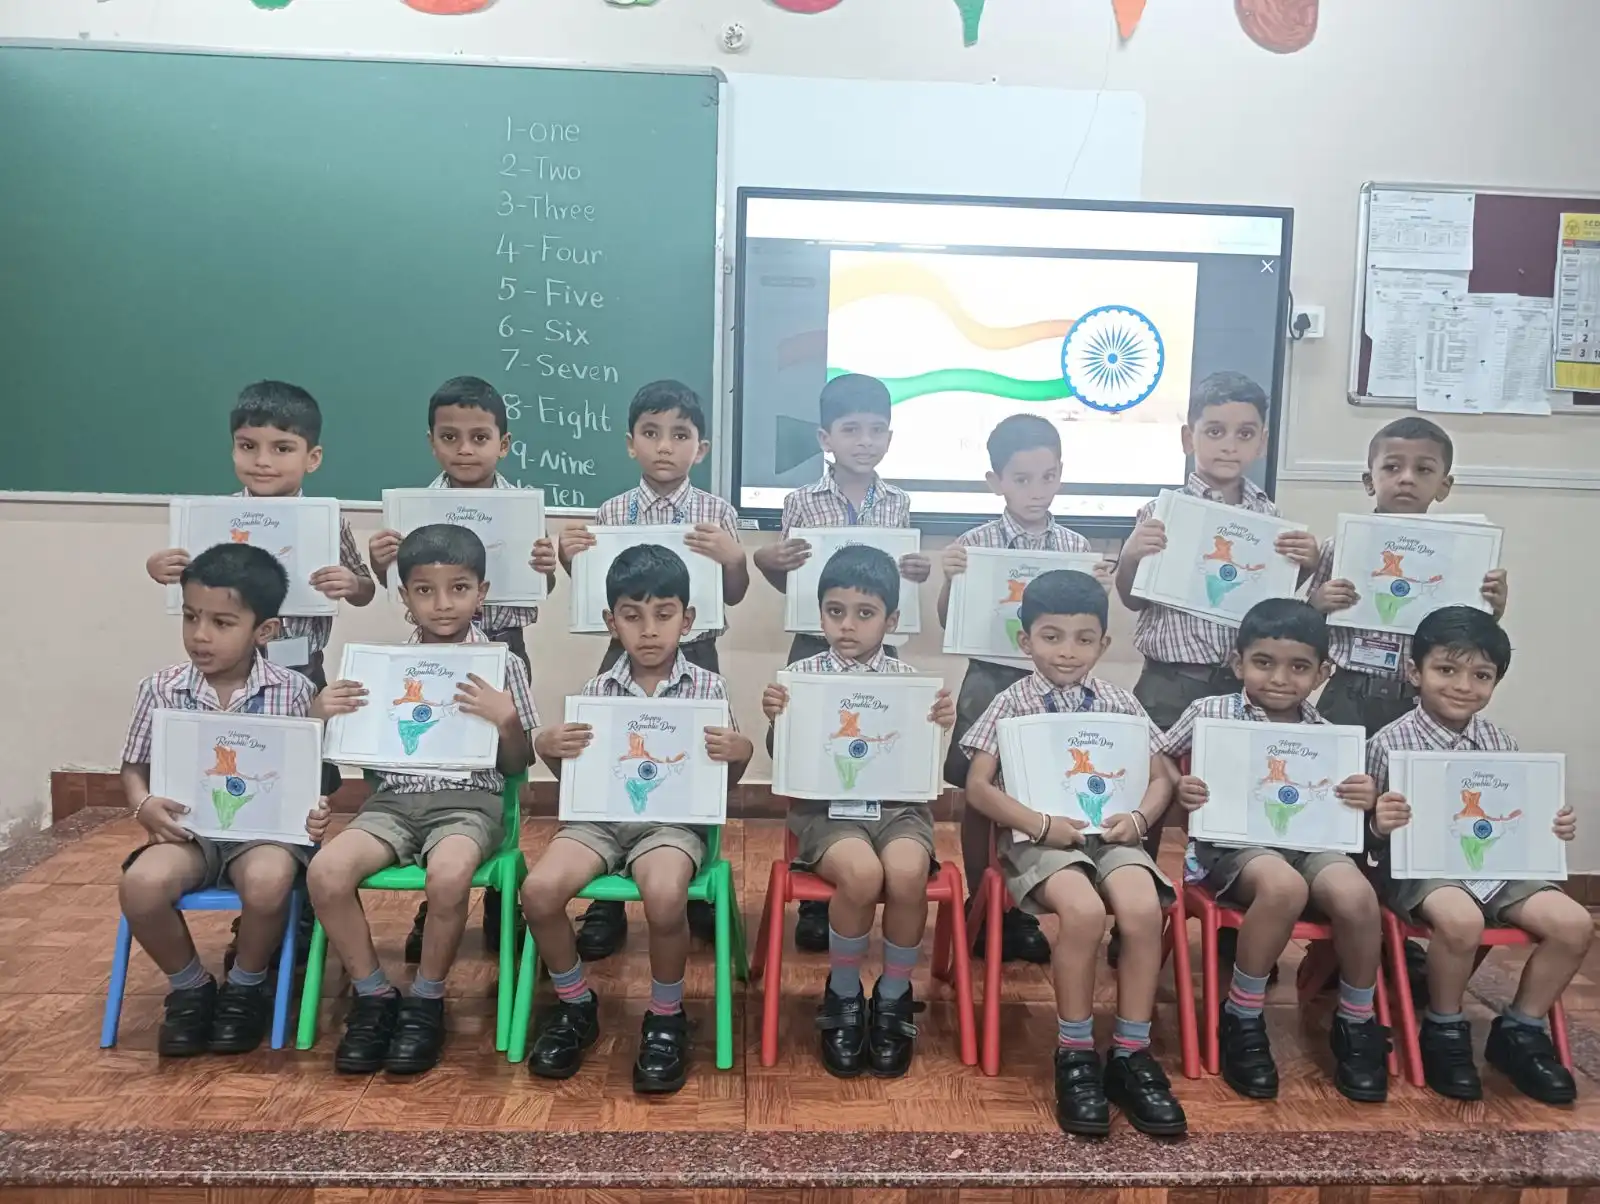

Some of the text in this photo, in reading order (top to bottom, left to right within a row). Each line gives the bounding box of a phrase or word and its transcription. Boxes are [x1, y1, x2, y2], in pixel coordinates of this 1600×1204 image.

[1582, 334, 1589, 343] 2
[1579, 348, 1586, 358] 3
[230, 517, 280, 528] Republic Day
[445, 511, 493, 523] Republic Day
[1216, 526, 1261, 546] Republic Day
[1384, 540, 1435, 556] Republic Day
[405, 666, 454, 679] Republic Day
[852, 692, 875, 702] Happy
[839, 698, 889, 713] Republic Day
[639, 712, 662, 723] Happy
[627, 720, 677, 733] Republic Day
[228, 730, 251, 740] Happy
[1078, 730, 1099, 739] Happy
[215, 735, 266, 752] Republic Day
[1067, 736, 1114, 750] Republic Day
[1278, 739, 1302, 749] Happy
[1266, 744, 1319, 760] Republic Day
[1461, 777, 1510, 791] Republic Day
